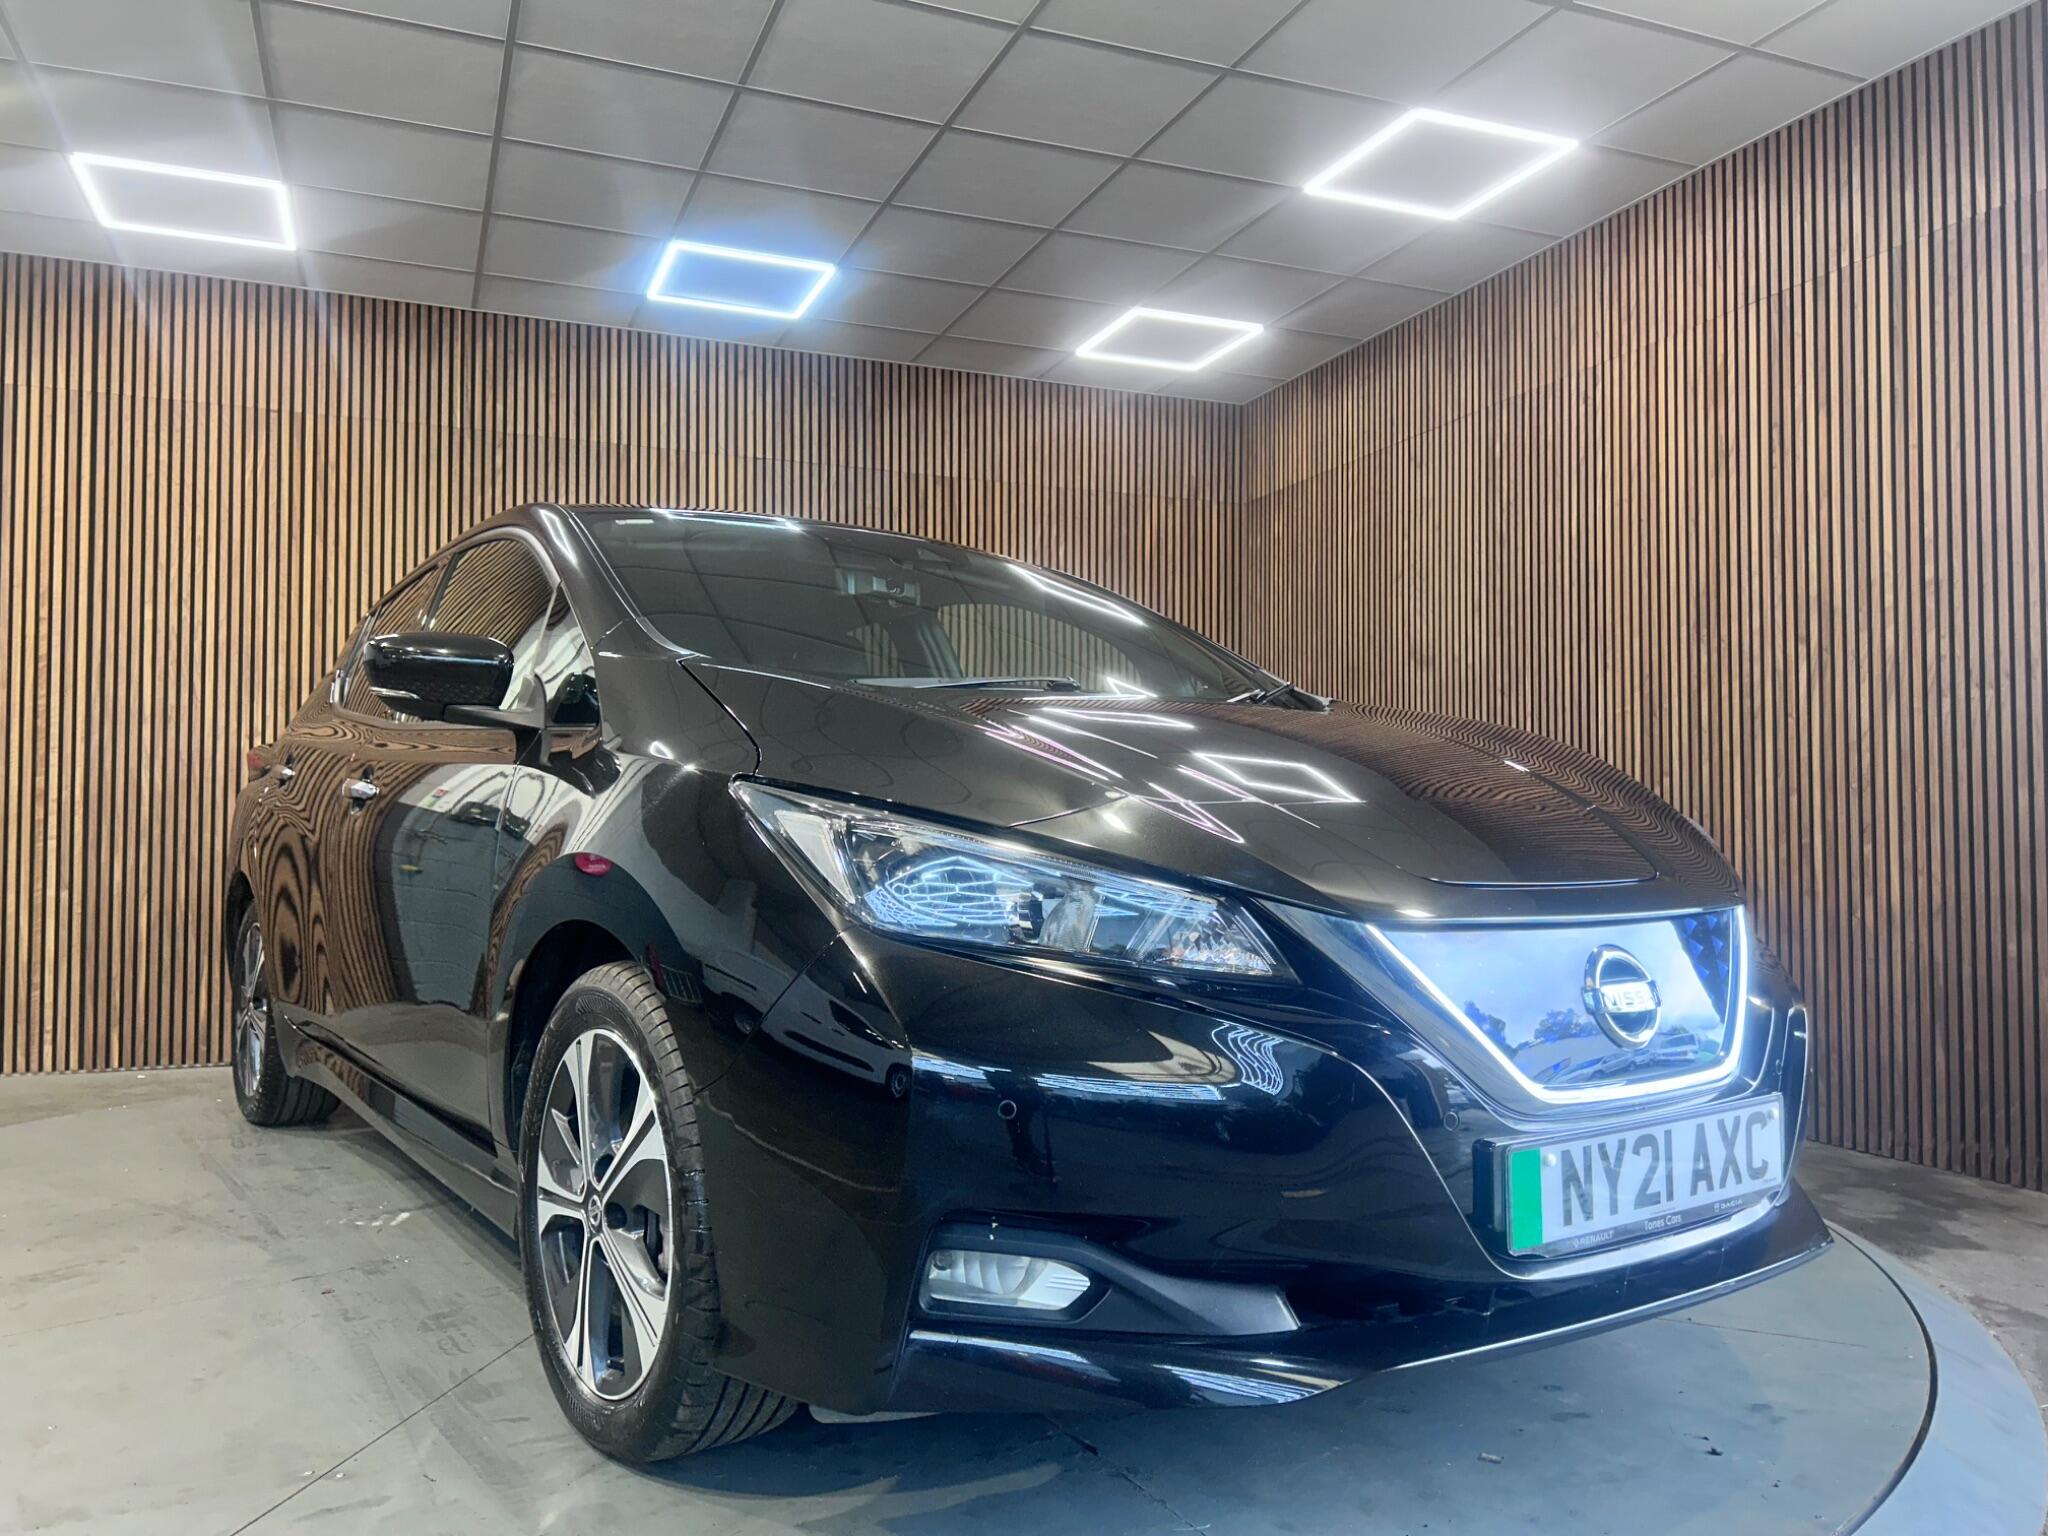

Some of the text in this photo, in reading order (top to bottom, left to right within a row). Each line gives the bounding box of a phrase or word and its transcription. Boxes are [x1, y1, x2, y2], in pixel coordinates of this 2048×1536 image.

[1602, 989, 1655, 1009] NISS
[1560, 1110, 1769, 1227] NY21 AXC
[1720, 1199, 1743, 1210] DACIA
